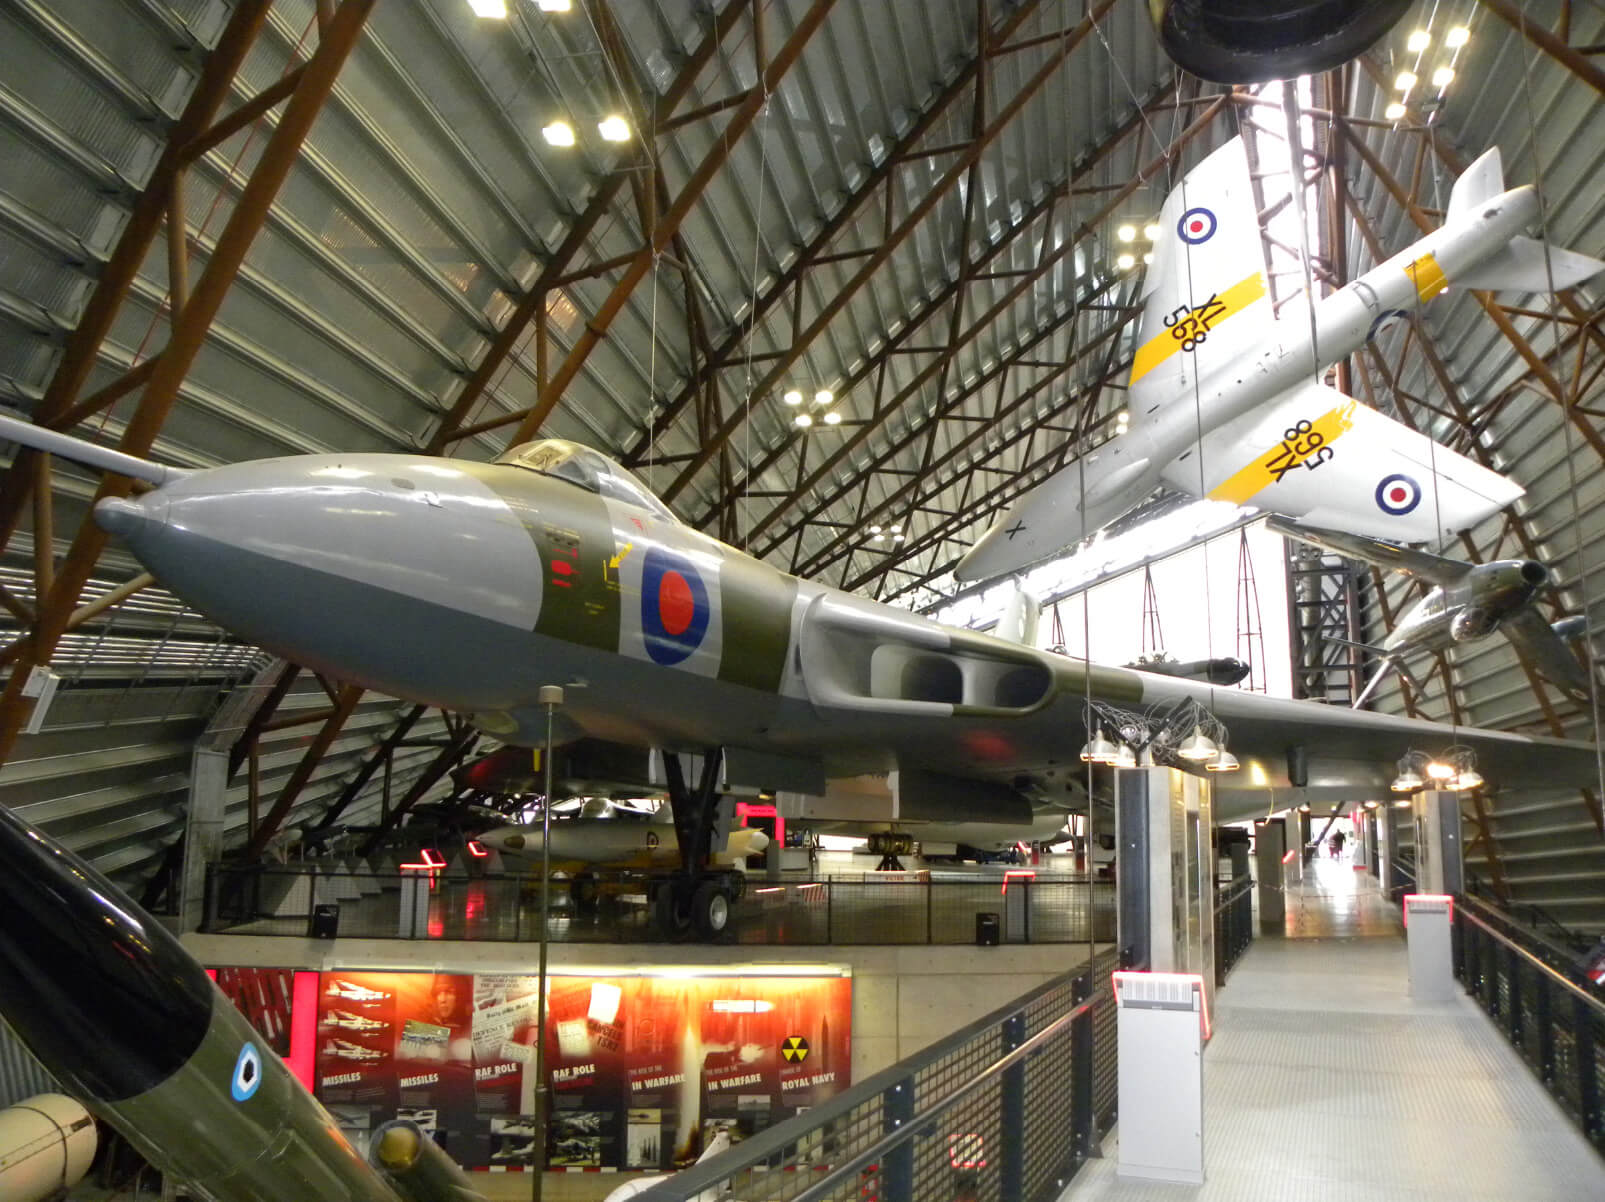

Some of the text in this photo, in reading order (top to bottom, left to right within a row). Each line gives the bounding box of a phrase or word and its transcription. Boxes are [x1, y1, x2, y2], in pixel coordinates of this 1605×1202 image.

[1191, 293, 1226, 332] XL
[1163, 304, 1207, 352] 568
[1283, 419, 1334, 471] 568
[1265, 441, 1302, 483] XL
[322, 1071, 361, 1087] MISSILES
[400, 1072, 439, 1088] MISSILES
[475, 1063, 518, 1081] RAF ROLE
[553, 1063, 596, 1082] RAF ROLE
[782, 1072, 835, 1091] ROYAL NAVY
[632, 1073, 686, 1091] IN WARFARE
[708, 1073, 761, 1091] IN WARFARE
